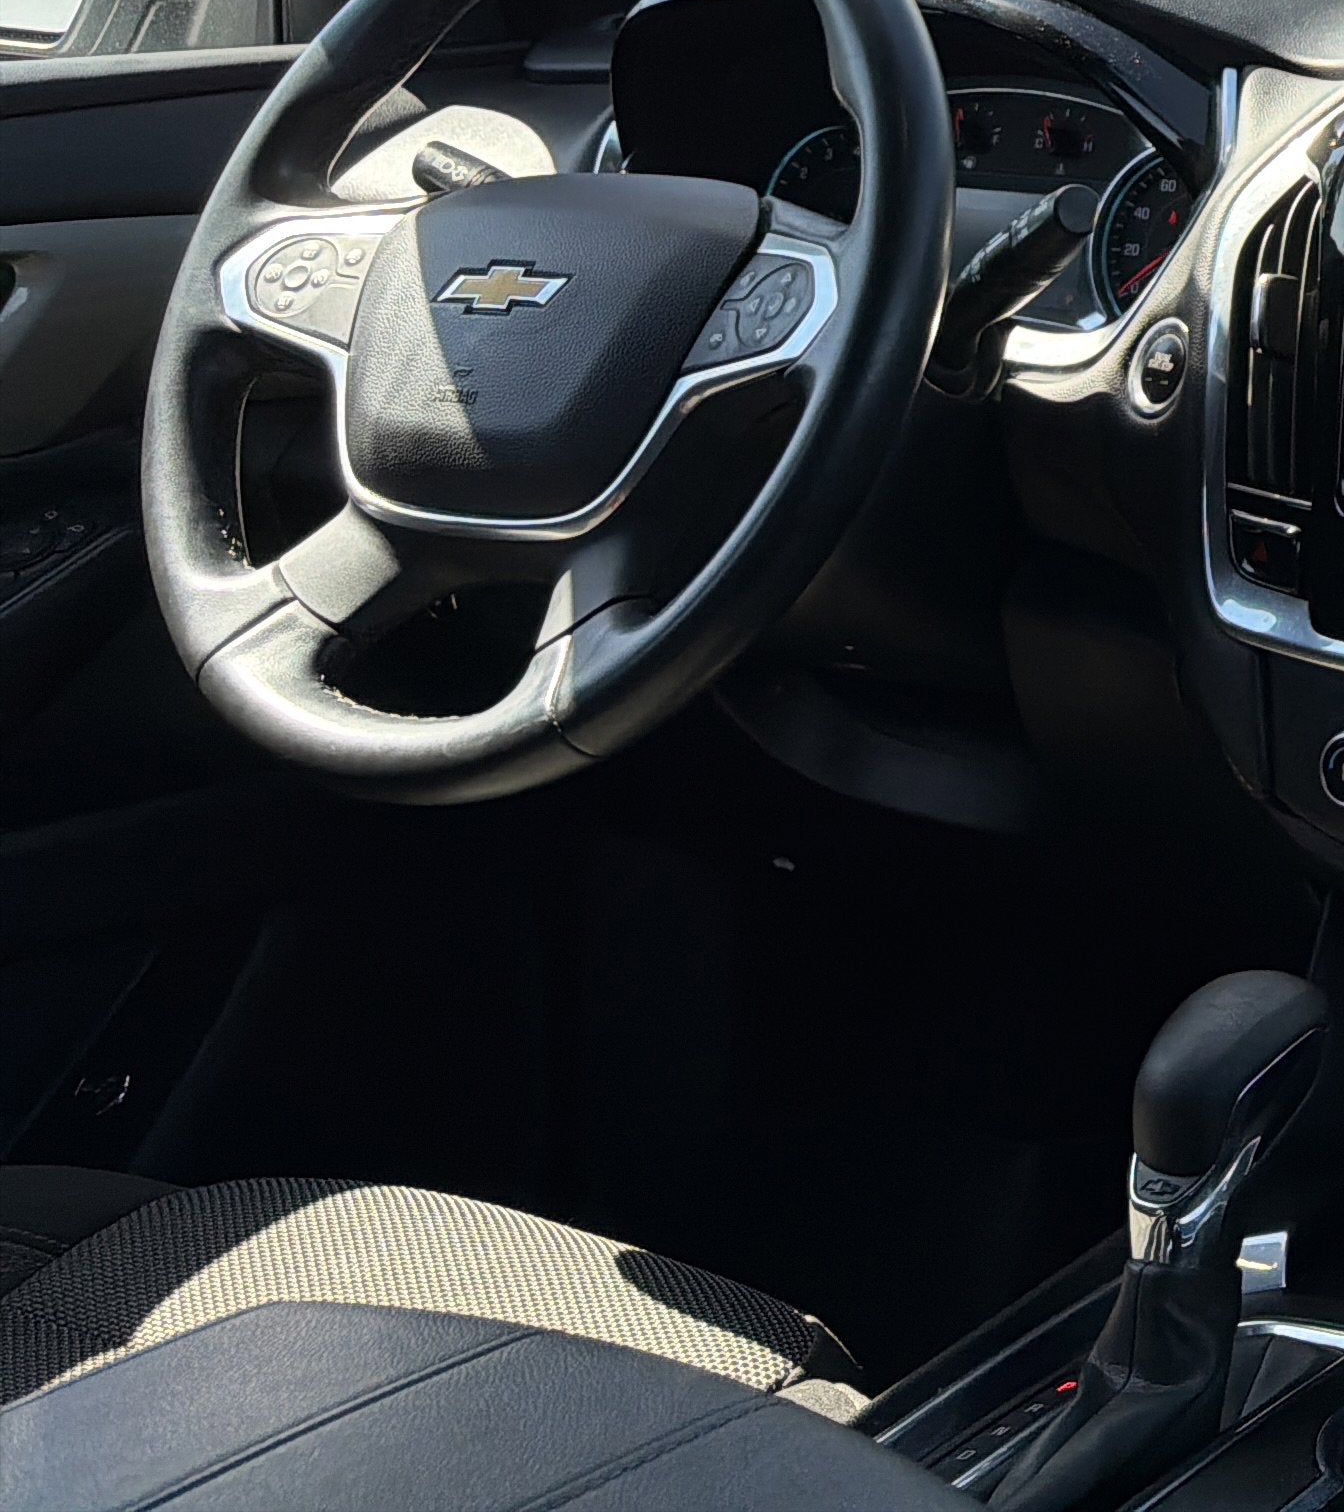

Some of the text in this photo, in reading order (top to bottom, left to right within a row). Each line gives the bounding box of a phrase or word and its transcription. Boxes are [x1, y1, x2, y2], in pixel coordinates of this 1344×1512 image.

[1160, 178, 1177, 193] 60
[1133, 206, 1151, 220] 40
[1123, 242, 1140, 257] 20
[956, 1449, 977, 1461] D
